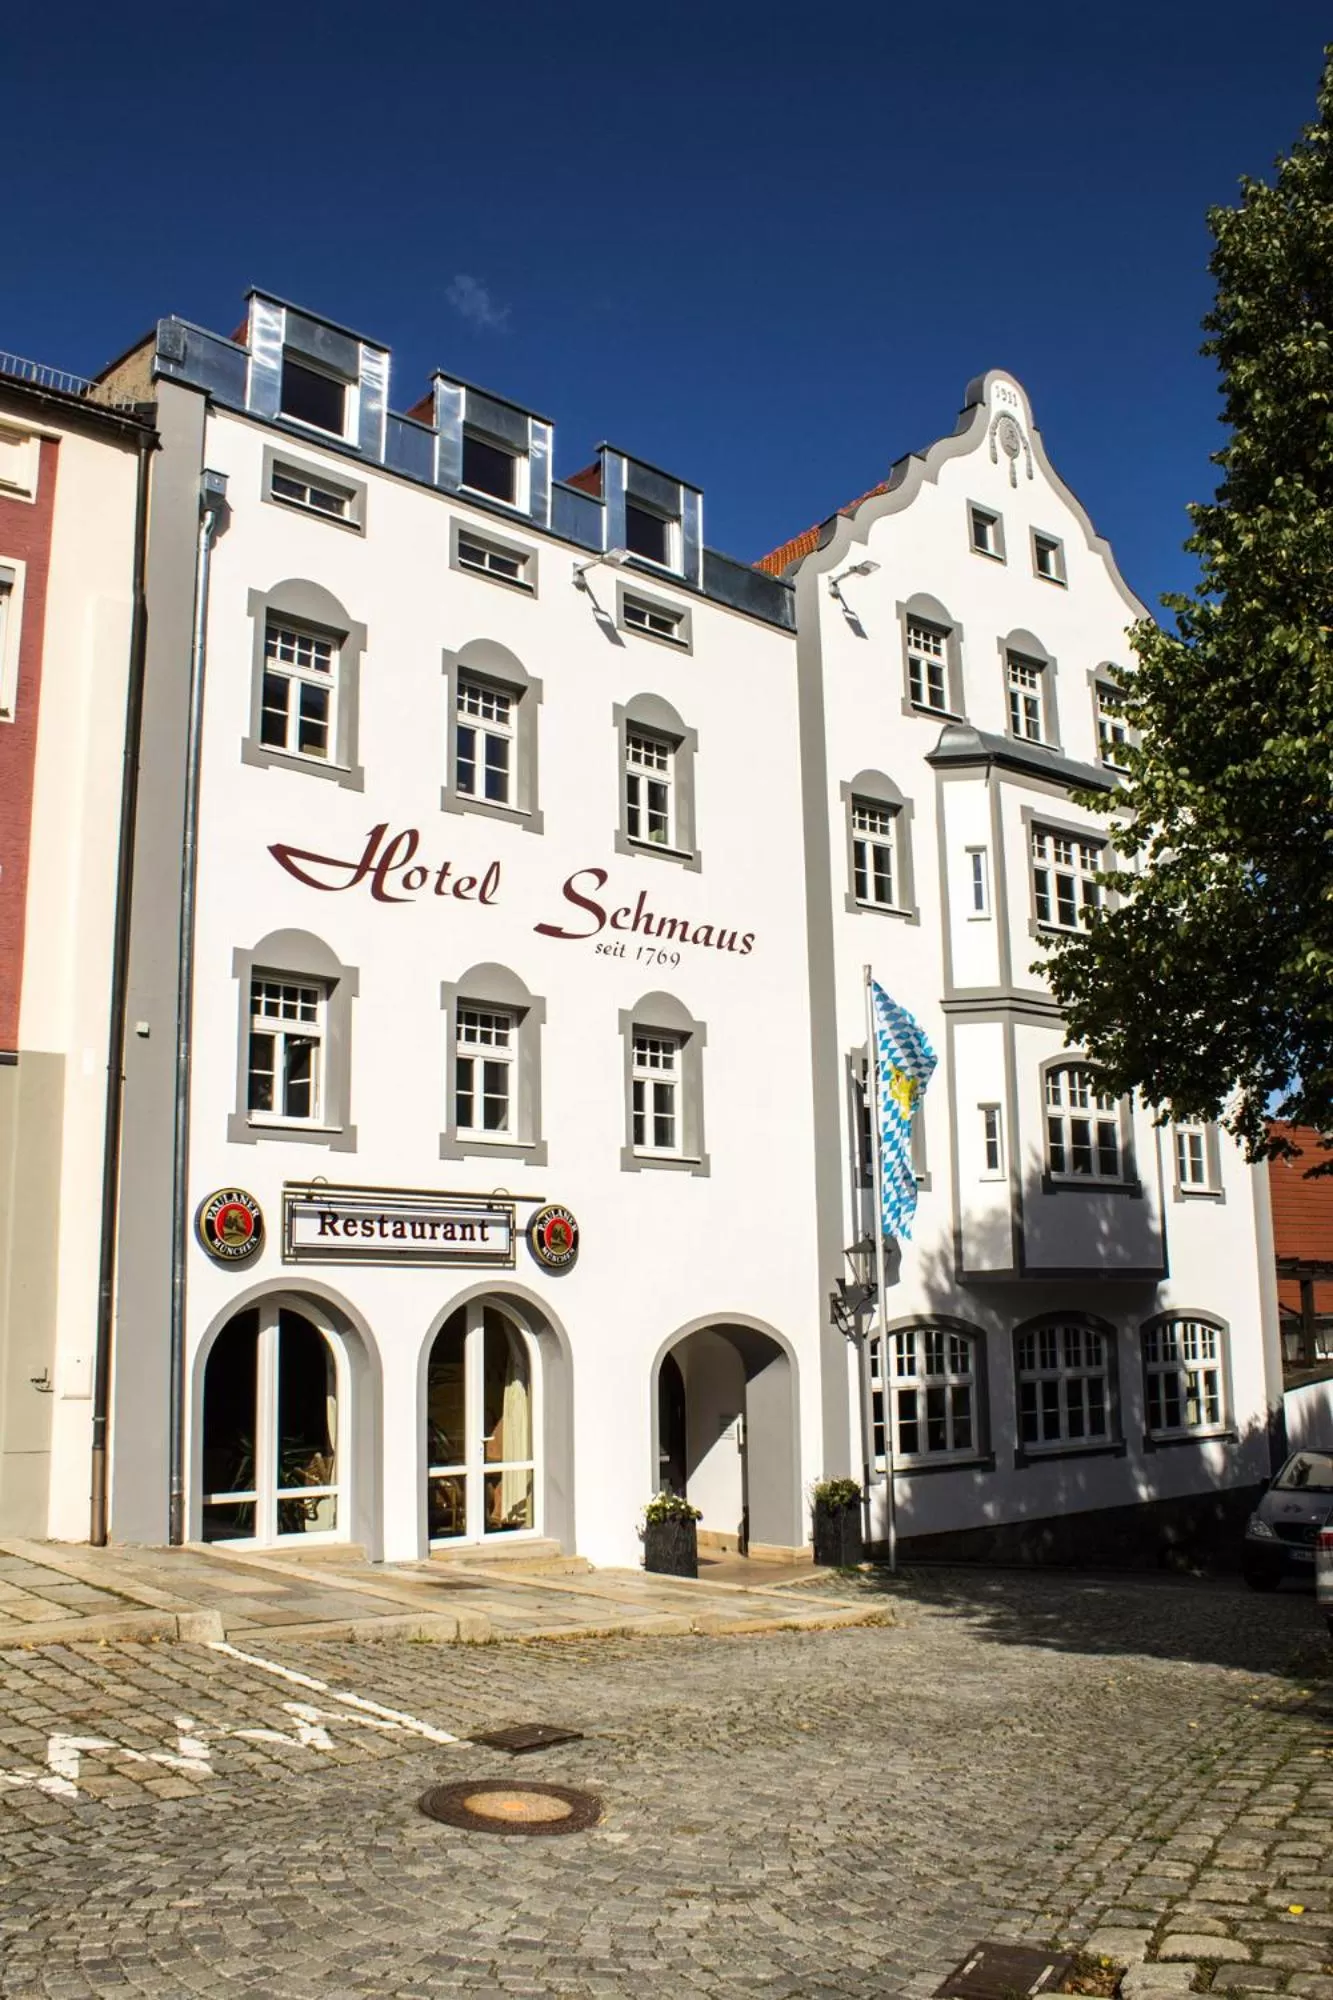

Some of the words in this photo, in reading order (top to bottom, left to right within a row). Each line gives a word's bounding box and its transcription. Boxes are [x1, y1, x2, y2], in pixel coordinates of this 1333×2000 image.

[267, 822, 501, 905] Hotel
[533, 867, 756, 956] Schmaus
[595, 941, 626, 958] seit
[636, 946, 681, 970] 1769
[206, 1192, 260, 1220] PAULANER
[318, 1211, 490, 1242] Restaurant
